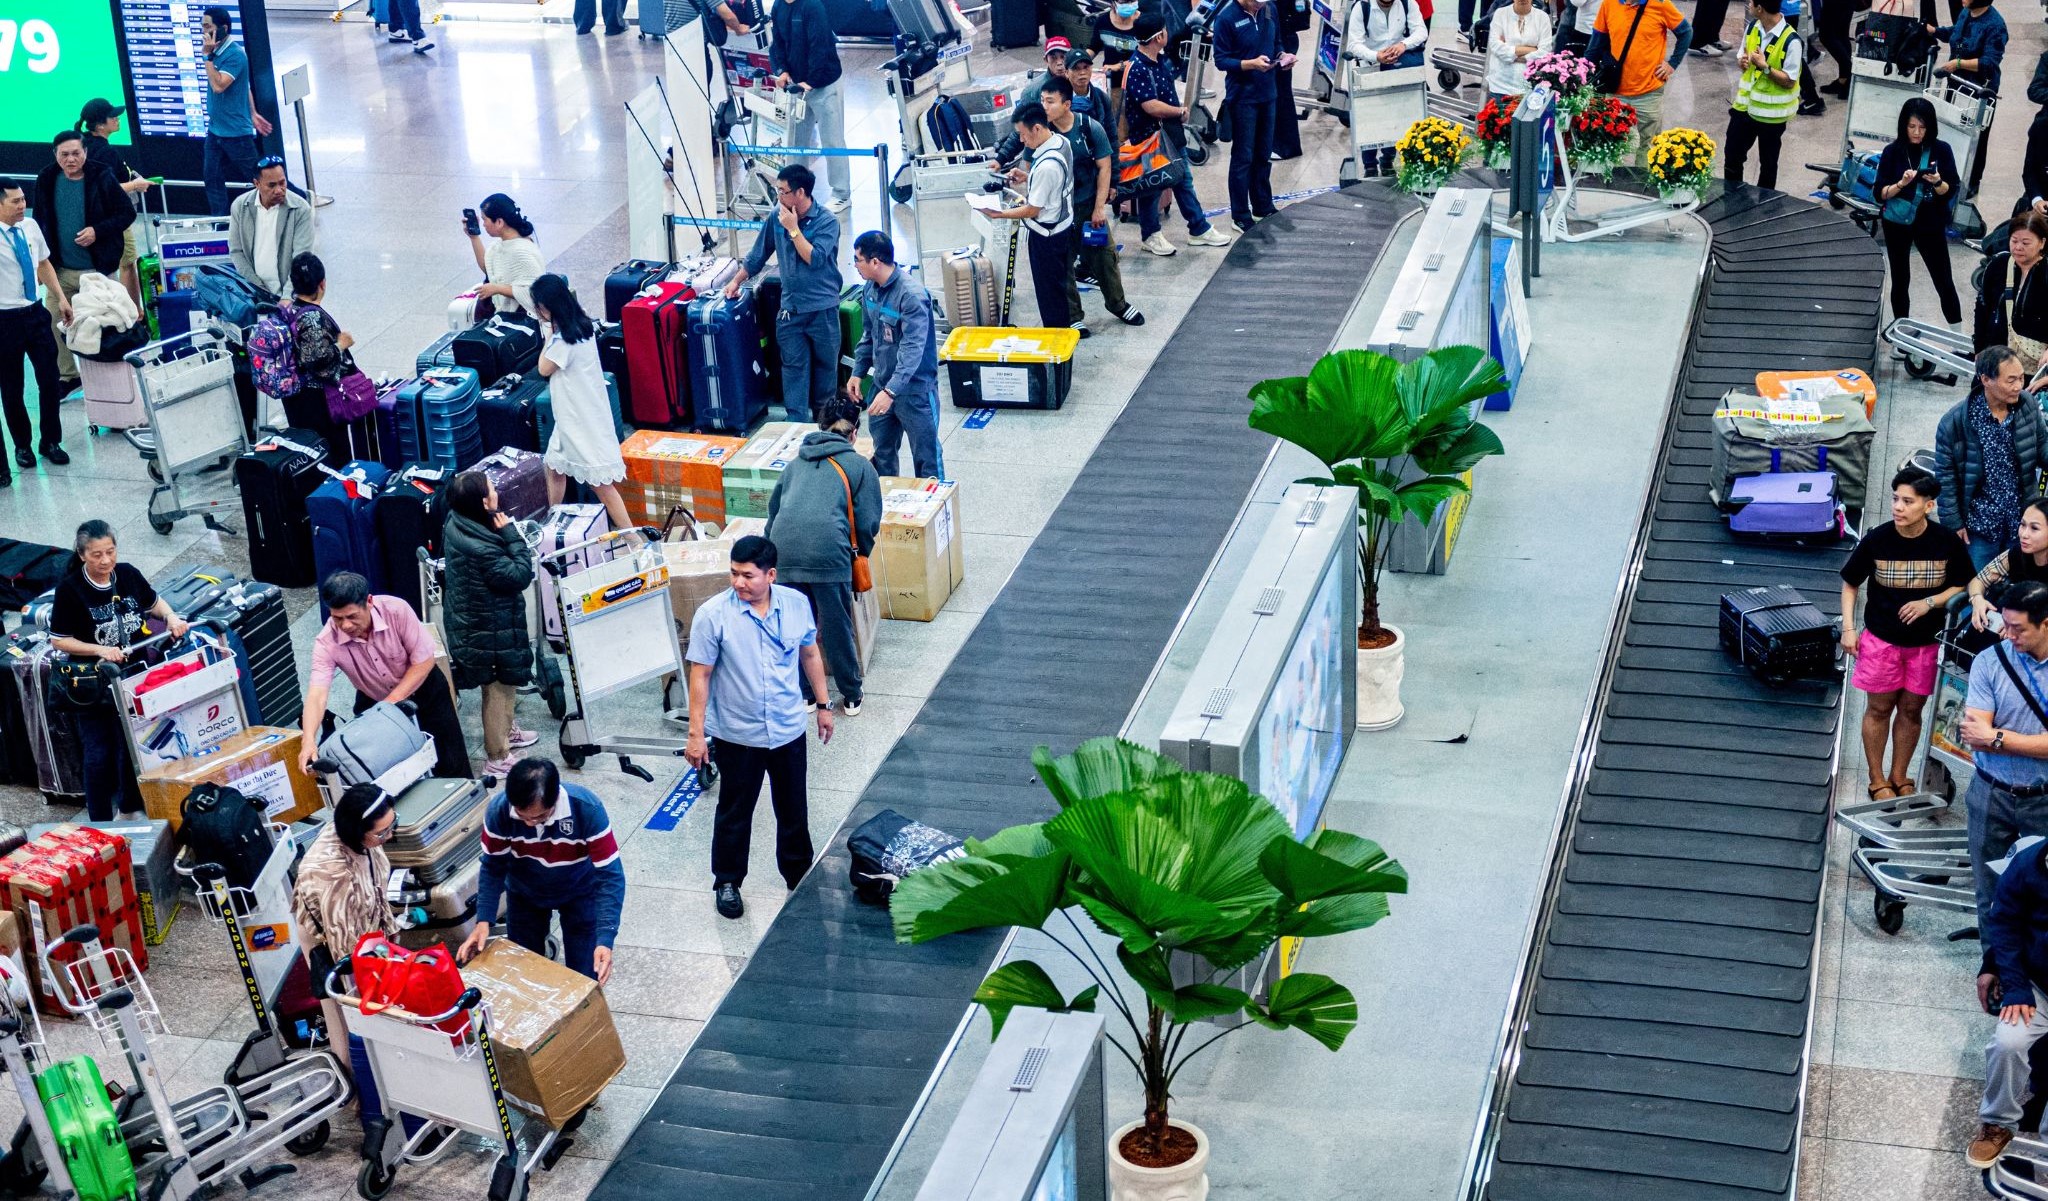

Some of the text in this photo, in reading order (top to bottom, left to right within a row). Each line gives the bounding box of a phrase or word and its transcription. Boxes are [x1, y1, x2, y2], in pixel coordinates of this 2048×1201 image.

[1541, 117, 1550, 189] 5
[1116, 171, 1173, 197] AUTICA
[288, 444, 327, 472] NAUCA
[198, 716, 235, 737] DORCO
[662, 773, 697, 812] wait here
[223, 908, 265, 1019] GOLDSUN GROUP
[480, 1032, 511, 1140] GOLDSUN GROUP
